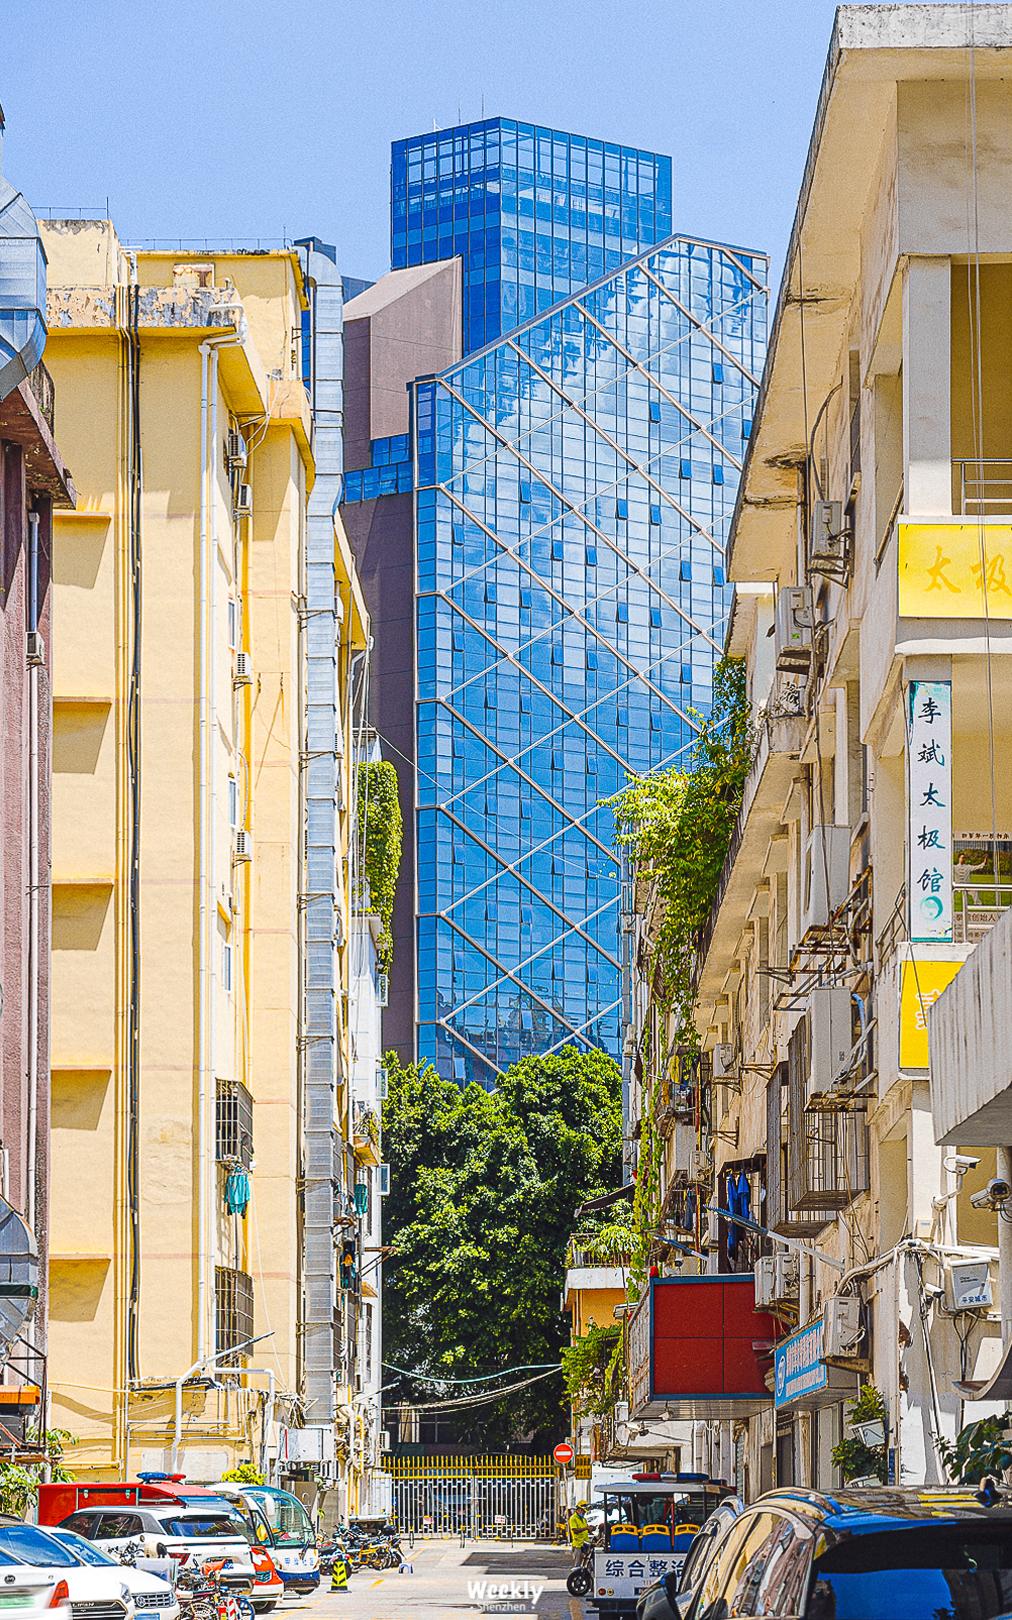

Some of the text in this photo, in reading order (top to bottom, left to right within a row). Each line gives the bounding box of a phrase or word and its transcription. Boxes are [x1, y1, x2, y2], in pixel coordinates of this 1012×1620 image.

[917, 697, 946, 893] 李斌太极馆
